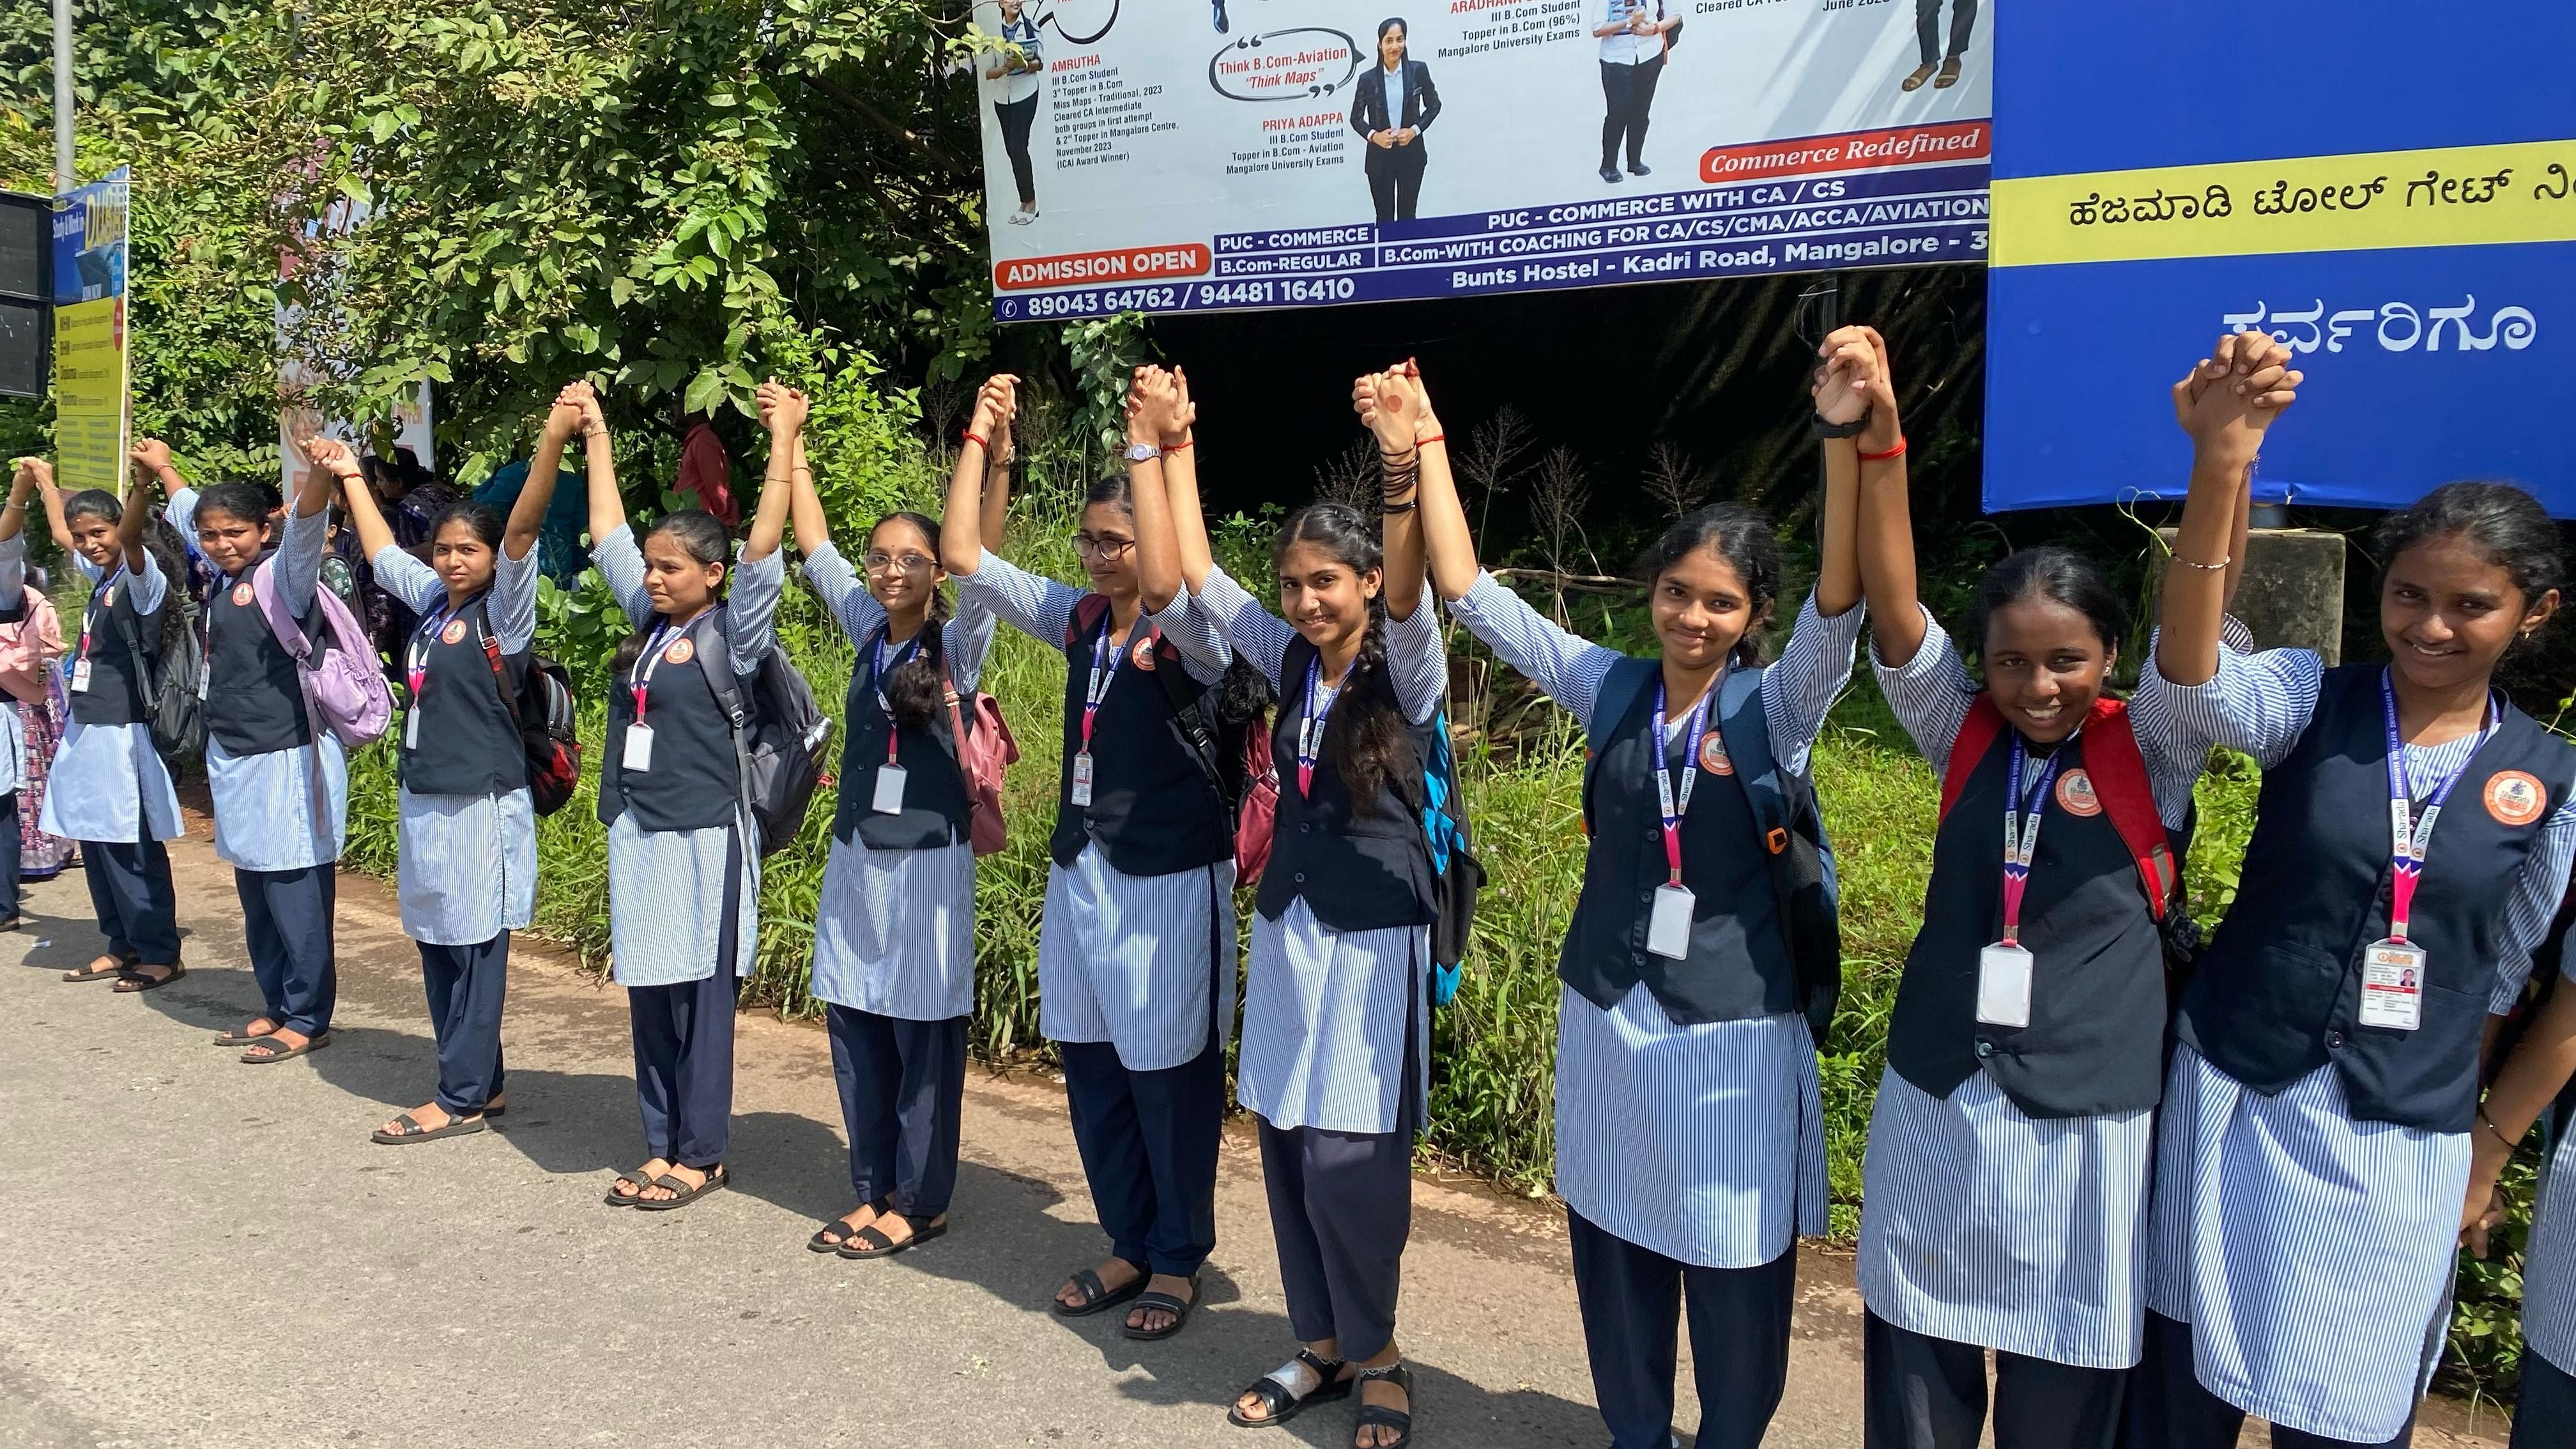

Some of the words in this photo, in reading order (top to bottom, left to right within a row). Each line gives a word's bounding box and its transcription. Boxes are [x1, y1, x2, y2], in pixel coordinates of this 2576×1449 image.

[1491, 12, 1501, 22] III
[1505, 8, 1538, 20] B.Com
[1542, 0, 1581, 14] Student
[1462, 28, 1496, 41] Topper
[1500, 26, 1508, 35] in
[1512, 20, 1545, 33] B.Com
[1549, 13, 1581, 29] (96%)
[1438, 43, 1490, 58] Mangalore
[1493, 34, 1543, 50] University
[1547, 29, 1580, 42] Exams
[1052, 54, 1101, 73] AMRUTHA
[1219, 59, 1250, 75] Think
[1254, 47, 1347, 70] B.Com-Aviation
[1062, 73, 1087, 84] B.Com
[1089, 66, 1119, 80] Student
[1062, 86, 1087, 97] Topper
[1090, 83, 1096, 92] in
[1099, 80, 1123, 90] B.Com
[1054, 99, 1070, 110] Miss
[1073, 97, 1092, 107] Maps
[1099, 89, 1141, 103] Traditional,
[1144, 85, 1162, 96] 2023
[1054, 110, 1081, 121] Cleared
[1084, 108, 1093, 117] CA
[1096, 101, 1142, 115] Intermediate
[1055, 123, 1070, 134] both
[1073, 121, 1096, 133] groups
[1099, 119, 1105, 127] in
[1108, 116, 1122, 126] first
[1124, 112, 1153, 125] attempt
[1056, 137, 1061, 145] &
[1074, 132, 1098, 144] Topper
[1101, 130, 1107, 139] in
[1110, 124, 1149, 137] Mangalore
[1263, 118, 1295, 132] PRIYA
[1298, 112, 1344, 128] ADAPPA
[1057, 144, 1092, 157] November
[1094, 141, 1112, 152] 2023
[1269, 135, 1278, 144] III
[1280, 133, 1308, 144] B.Com
[1311, 128, 1344, 141] Student
[1057, 158, 1074, 171] (ICAI
[1077, 155, 1098, 166] Award
[1100, 151, 1130, 164] Winner)
[1232, 151, 1260, 162] Topper
[1262, 149, 1270, 158] in
[1273, 147, 1300, 158] B.Com
[1309, 142, 1344, 154] Aviation
[1711, 146, 1838, 174] Commerce
[1845, 128, 1981, 160] Redefined
[1227, 162, 1269, 175] Mangalore
[1272, 158, 1314, 171] University
[1316, 156, 1344, 166] Exams
[1488, 211, 1529, 229] PUC
[1549, 196, 1675, 224] COMMERCE
[1681, 190, 1744, 210] WITH
[1751, 186, 1786, 204] CA
[1791, 182, 1806, 203] /
[1812, 180, 1846, 199] CS
[2069, 184, 2232, 226] ಹೆಜಮಾಡಿ
[2254, 175, 2388, 215] ಟೋಲ್
[2406, 167, 2515, 207] ಗೇಟ್
[1220, 235, 1254, 251] PUC
[1268, 227, 1368, 247] COMMERCE
[1384, 240, 1494, 263] B.Com-WITH
[1499, 230, 1602, 254] COACHING
[1607, 226, 1650, 245] FOR
[1655, 197, 1989, 240] CA/CS/CMA/ACCA/AVIATION
[1007, 256, 1126, 284] ADMISSION
[1133, 250, 1196, 273] OPEN
[1221, 252, 1361, 273] B.Com-REGULAR
[1453, 268, 1517, 289] Bunts
[1524, 258, 1599, 282] Hostel
[1623, 250, 1691, 275] Kadri
[1699, 245, 1776, 268] Road,
[1785, 235, 1940, 263] Mangalore
[1028, 292, 1098, 316] 89043
[1104, 287, 1175, 310] 64762
[1181, 284, 1193, 309] /
[1200, 281, 1273, 305] 94481
[1280, 277, 1355, 302] 16410
[1313, 722, 1324, 748] Sharada
[1662, 771, 1671, 804] Sharada
[1681, 769, 1694, 801] Sharada
[2394, 761, 2404, 797] SHUBHODAYA
[2007, 812, 2016, 848] Sharada
[2023, 815, 2039, 850] Sharada
[2397, 801, 2407, 839] Sharada
[2416, 808, 2437, 845] Sharada
